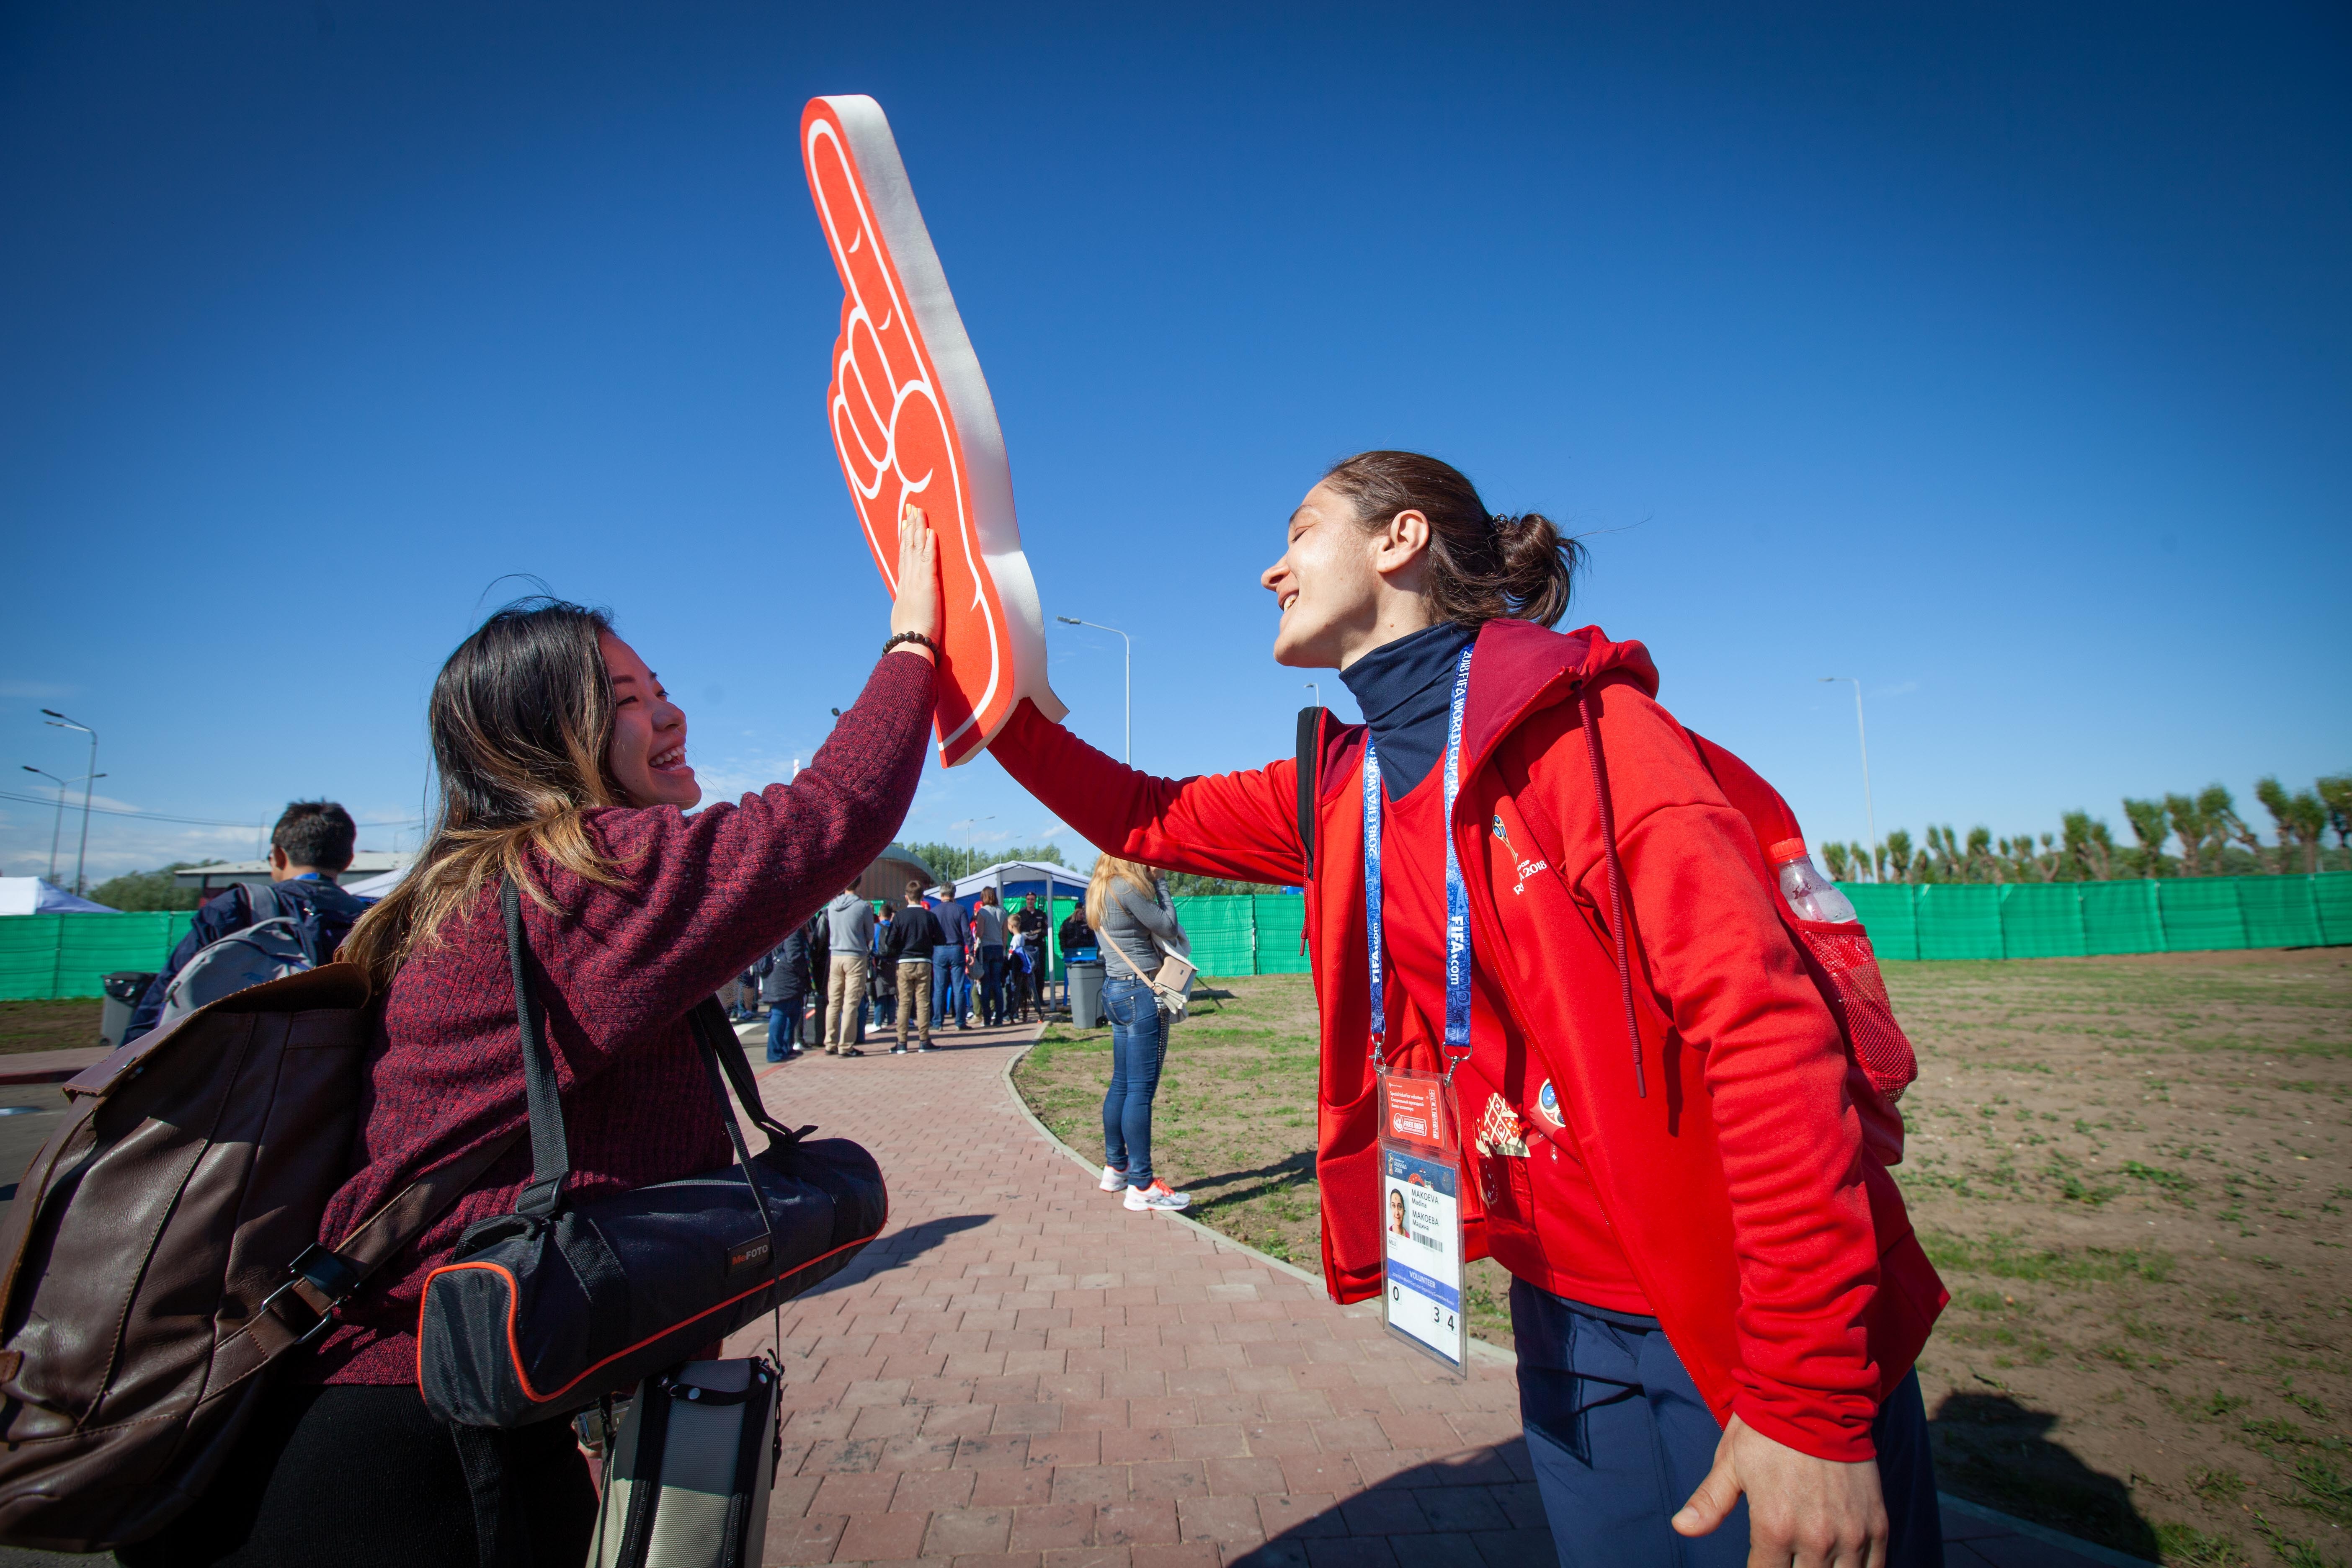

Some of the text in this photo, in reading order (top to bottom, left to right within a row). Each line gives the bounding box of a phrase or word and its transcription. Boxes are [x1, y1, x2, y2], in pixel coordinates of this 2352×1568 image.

[1460, 650, 1473, 672] 2018
[1455, 672, 1469, 698] FIFA
[1451, 697, 1465, 745] WORLD
[1449, 746, 1460, 776] CUP
[1367, 792, 1377, 823] FIFA
[1368, 824, 1377, 856] 2018
[1523, 860, 1547, 878] 2018
[1451, 916, 1464, 985] FIFA.com
[1394, 1161, 1407, 1170] RUSSIA
[1411, 1188, 1439, 1204] MAKOEVA
[1411, 1198, 1427, 1208] Madina
[1412, 1210, 1439, 1227] МАКОЕВА
[1412, 1219, 1429, 1231] Мадина
[732, 1244, 768, 1265] MeFOTO
[1409, 1270, 1436, 1289] VOLUNTEER
[1434, 1306, 1440, 1323] 3
[1447, 1315, 1455, 1331] 4
